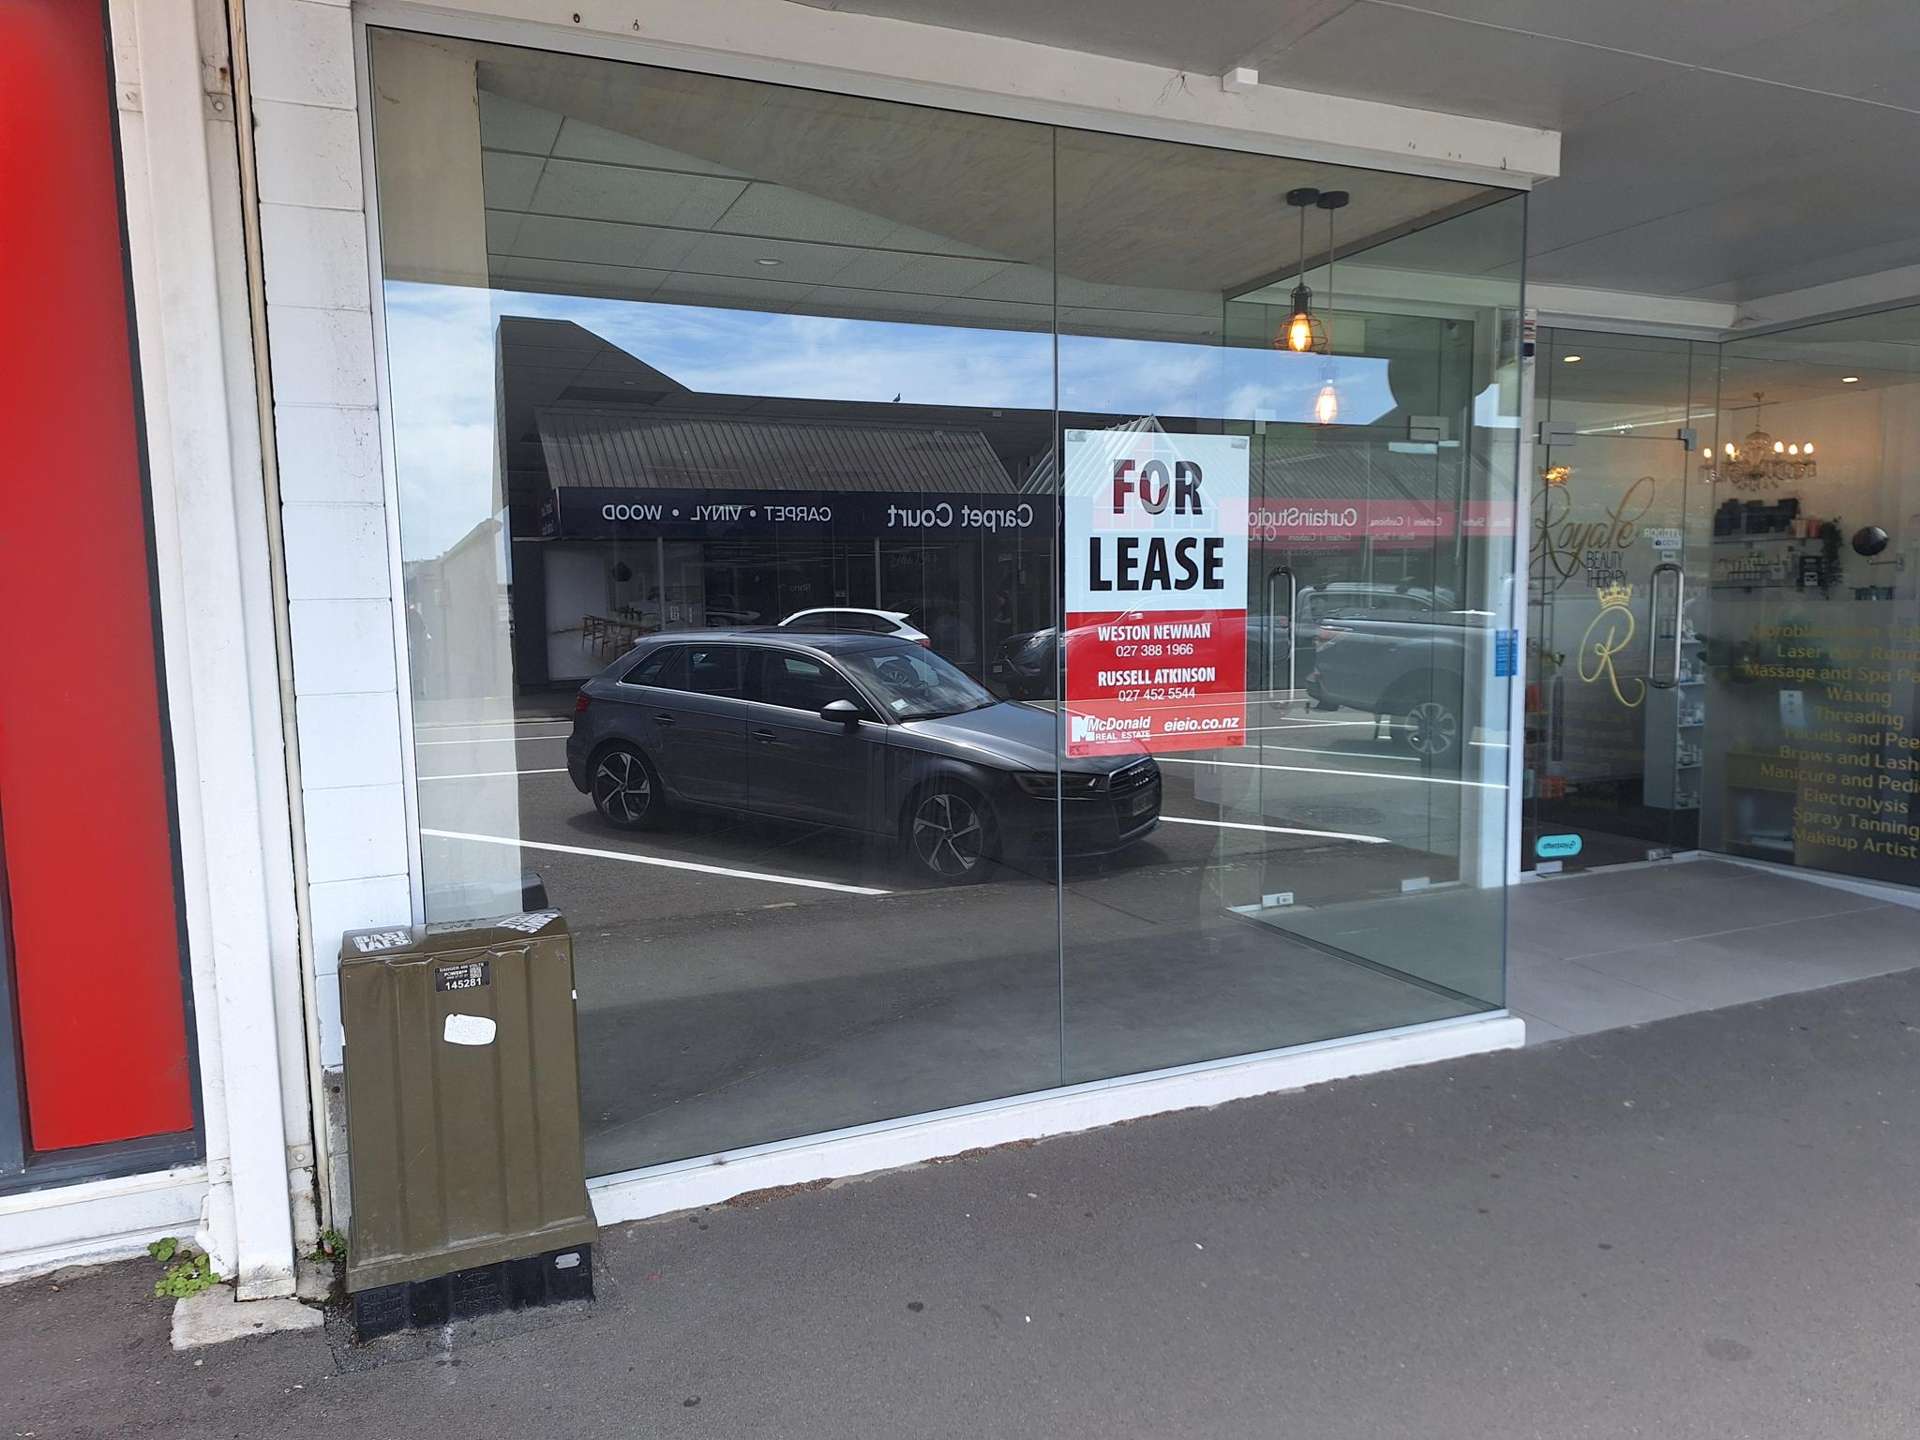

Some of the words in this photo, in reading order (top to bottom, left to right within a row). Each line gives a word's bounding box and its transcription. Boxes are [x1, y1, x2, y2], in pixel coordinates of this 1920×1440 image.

[1113, 459, 1203, 515] FOR
[1089, 537, 1224, 592] LEASE
[1586, 551, 1624, 569] BEAUTY
[1098, 624, 1150, 642] WESTON
[1153, 622, 1211, 640] NEWMAN
[1116, 645, 1139, 657] 027
[1141, 644, 1163, 657] 388
[1166, 643, 1193, 655] 1966
[1579, 606, 1646, 707] R
[1098, 670, 1152, 687] RUSSELL
[1154, 667, 1215, 685] ATKINSON
[1744, 663, 1815, 682] Massage
[1821, 668, 1851, 681] and
[1858, 667, 1891, 683] Spa
[1118, 690, 1139, 702] 027
[1141, 689, 1163, 701] 452
[1168, 688, 1195, 700] 5544
[1827, 686, 1892, 708] Waxing
[1087, 716, 1151, 731] McDonald
[1164, 716, 1240, 732] eieio.co.nz
[1814, 704, 1904, 730] Threading
[1095, 732, 1118, 741] REAL
[1121, 730, 1150, 740] ESTATE
[1847, 732, 1880, 746] and
[1779, 745, 1833, 762] Brows
[1838, 753, 1870, 767] and
[1760, 762, 1836, 784] Manicure
[1841, 774, 1873, 788] and
[1878, 775, 1920, 793] Pedi
[1803, 787, 1909, 814] Electrolysis
[1793, 807, 1842, 829] Spray
[1849, 814, 1920, 840] Tanning
[1793, 828, 1858, 850] Makeup
[445, 977, 481, 990] 145281
